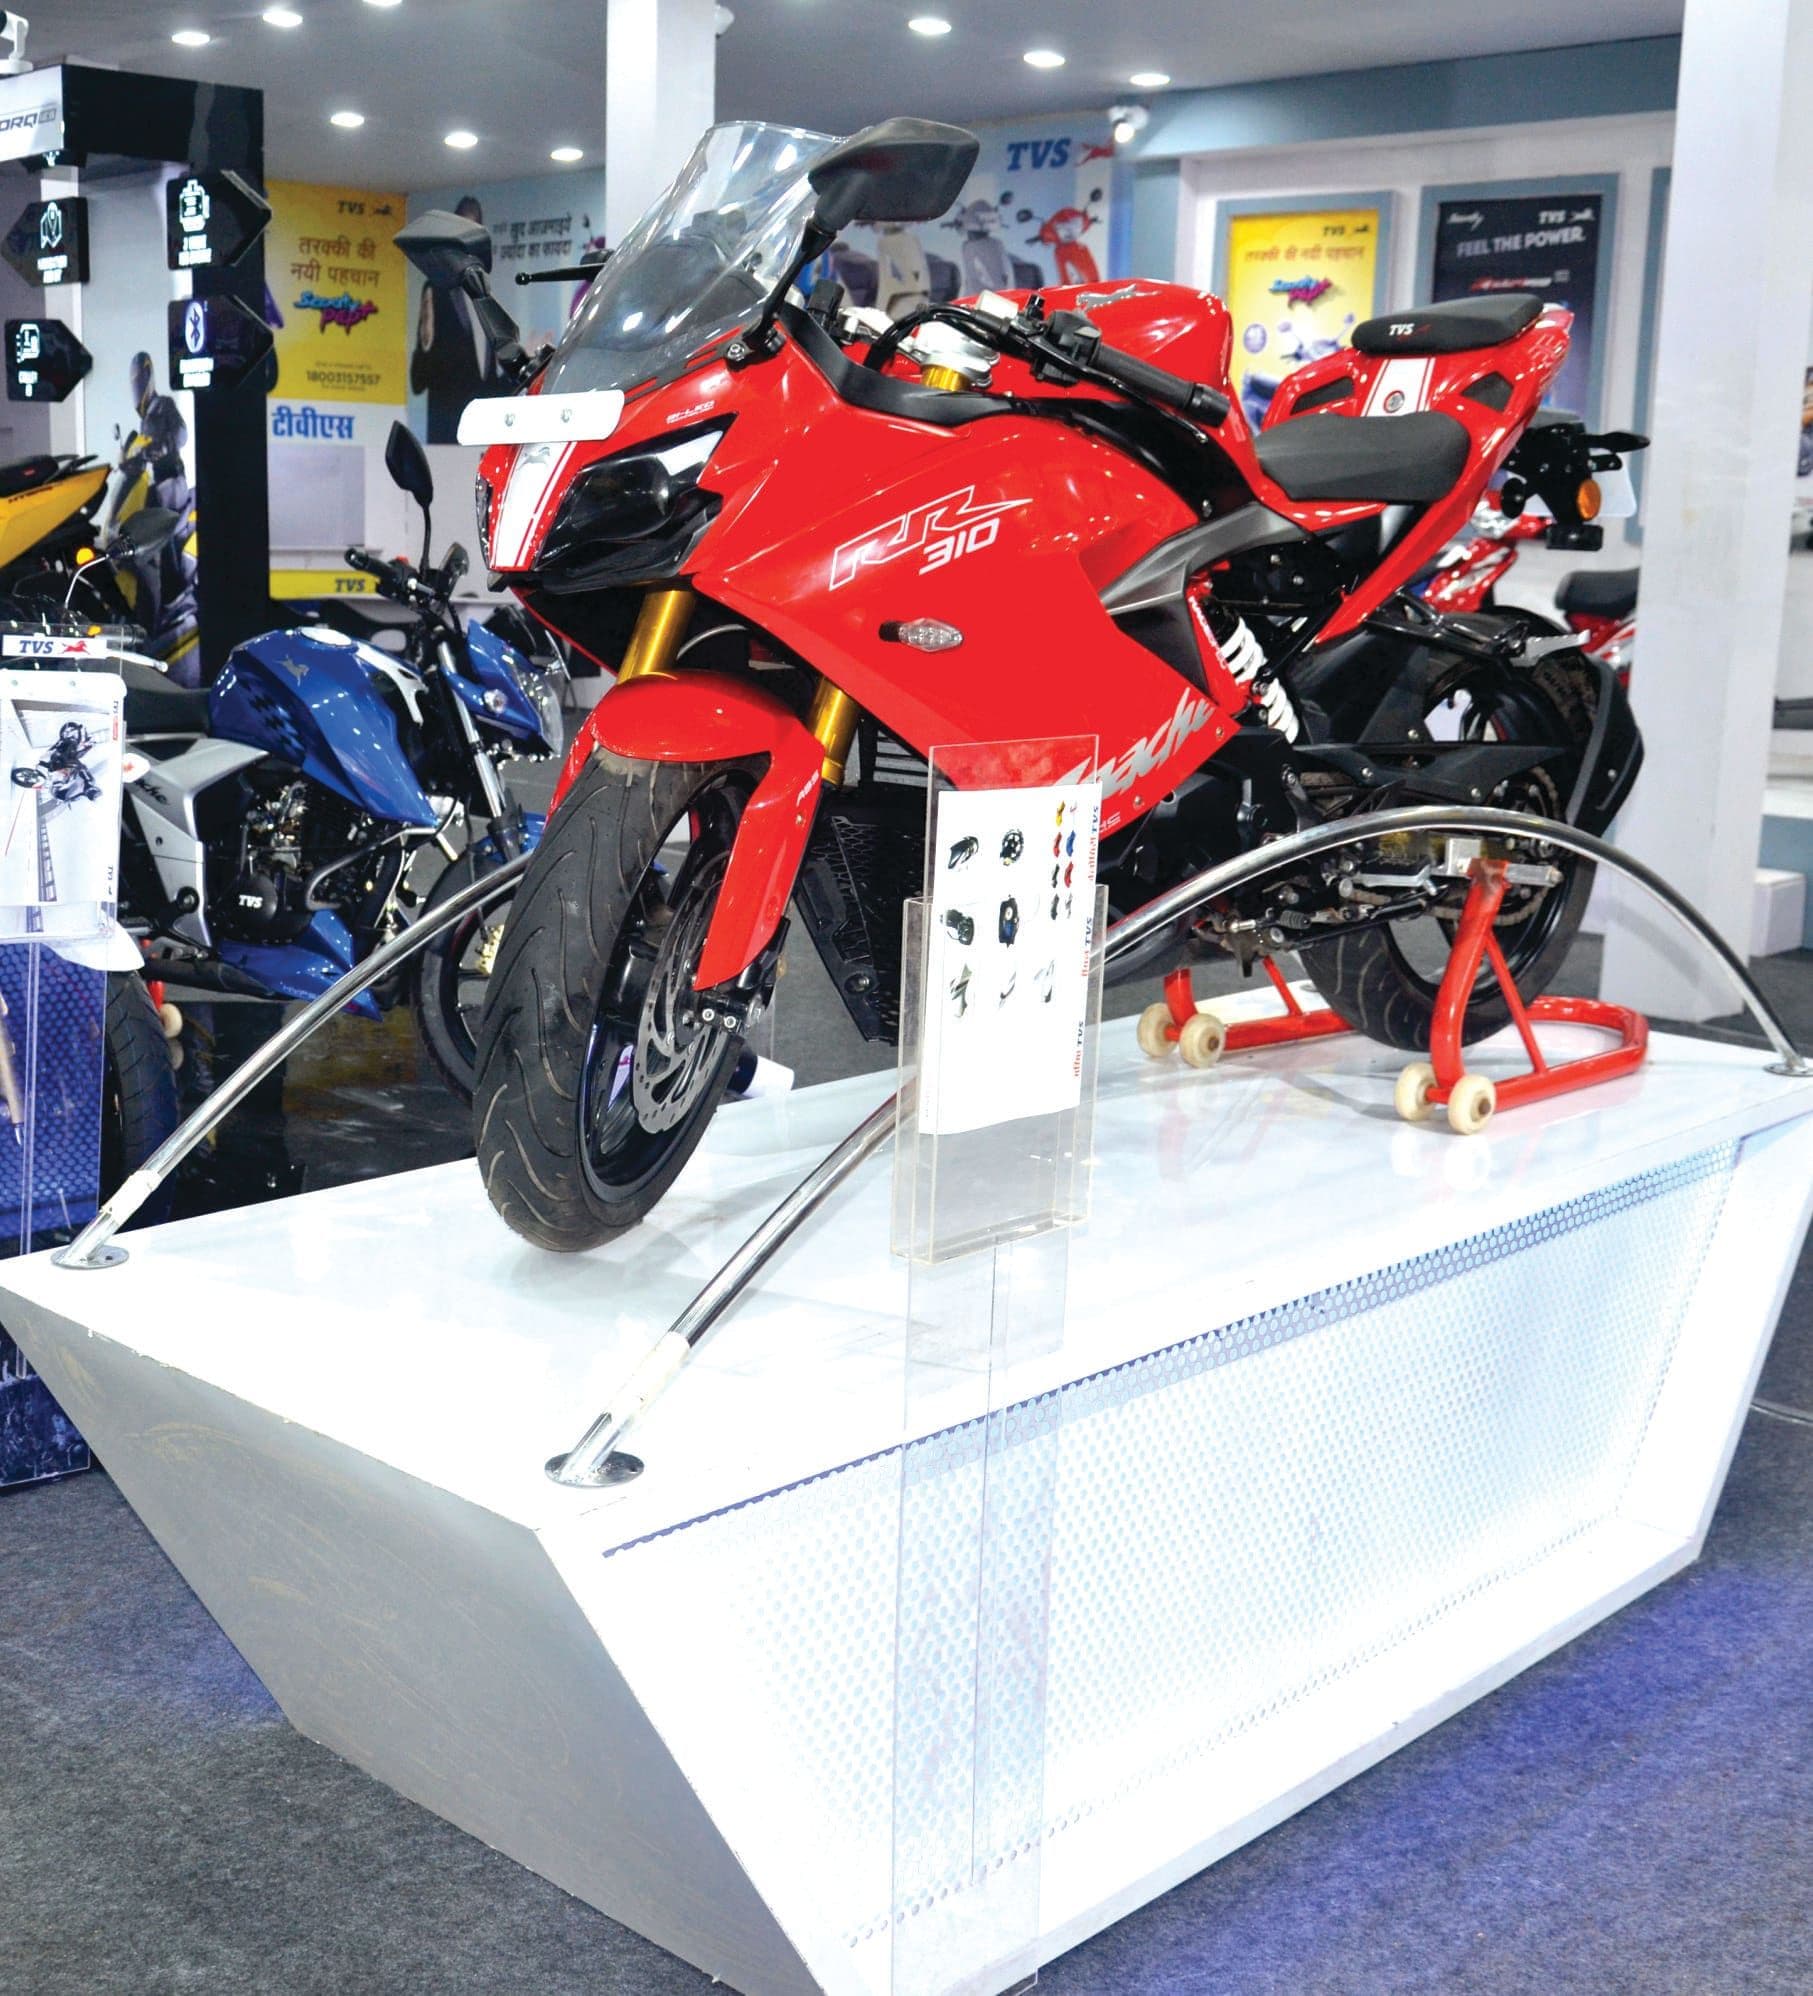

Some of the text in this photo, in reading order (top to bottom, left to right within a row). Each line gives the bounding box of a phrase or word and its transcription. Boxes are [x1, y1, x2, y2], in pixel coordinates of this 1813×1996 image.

[1007, 138, 1071, 171] TVS
[337, 200, 364, 214] TVS
[1538, 210, 1566, 224] TVS
[1323, 225, 1346, 236] TVS
[357, 237, 376, 260] की
[1456, 238, 1490, 258] FEEL
[1493, 233, 1521, 253] THE
[1389, 323, 1415, 336] TVS
[271, 405, 355, 439] टीवीएस
[829, 484, 1034, 591] RR
[918, 517, 1001, 575] 310
[335, 578, 365, 592] TVS
[20, 640, 54, 654] TVS
[238, 894, 263, 908] TVS
